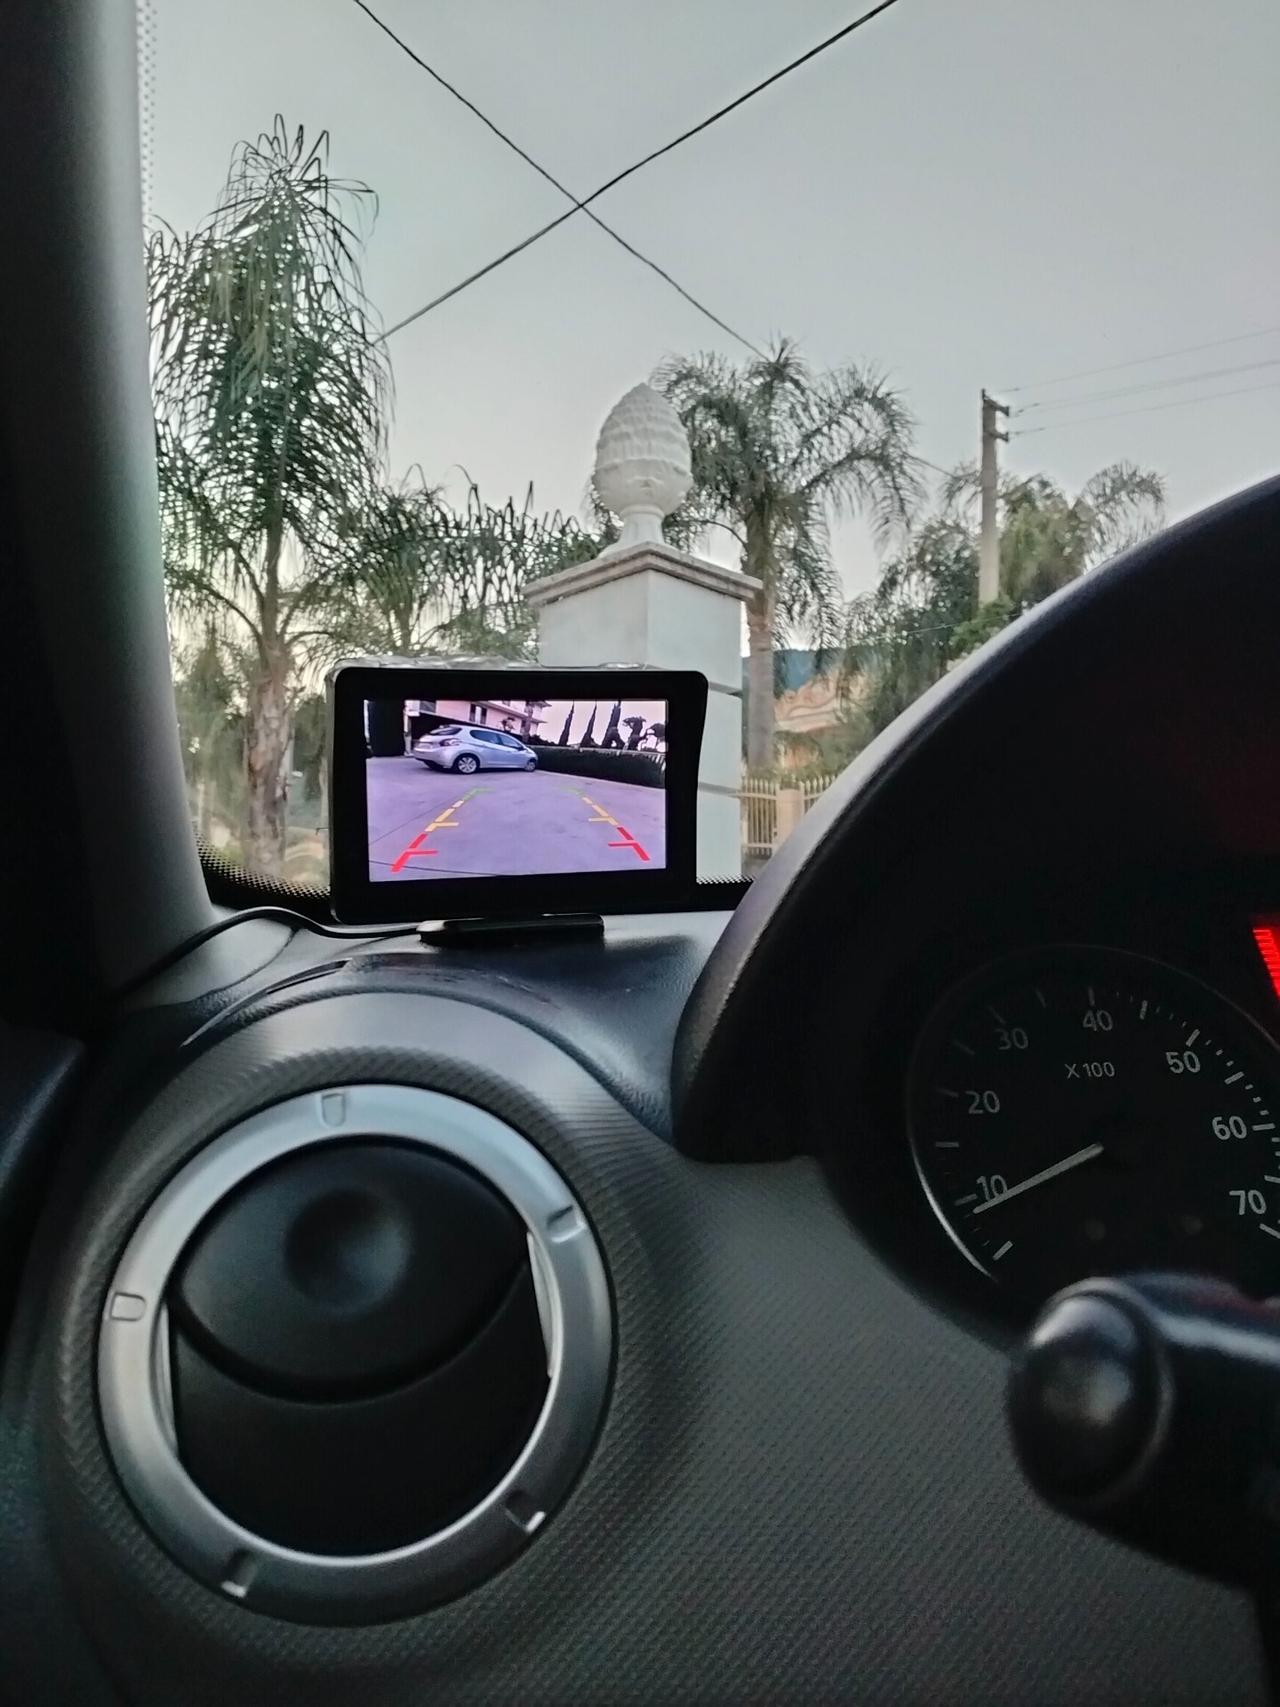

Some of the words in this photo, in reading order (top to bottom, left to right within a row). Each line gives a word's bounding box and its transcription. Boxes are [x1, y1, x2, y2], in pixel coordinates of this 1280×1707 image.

[1082, 1010, 1113, 1032] 40
[998, 1027, 1029, 1049] 30
[1083, 1062, 1116, 1079] 100
[1166, 1051, 1201, 1074] 50
[965, 1090, 1001, 1114] 20
[1212, 1115, 1248, 1140] 60
[976, 1174, 1008, 1200] 10
[1229, 1189, 1267, 1215] 70
